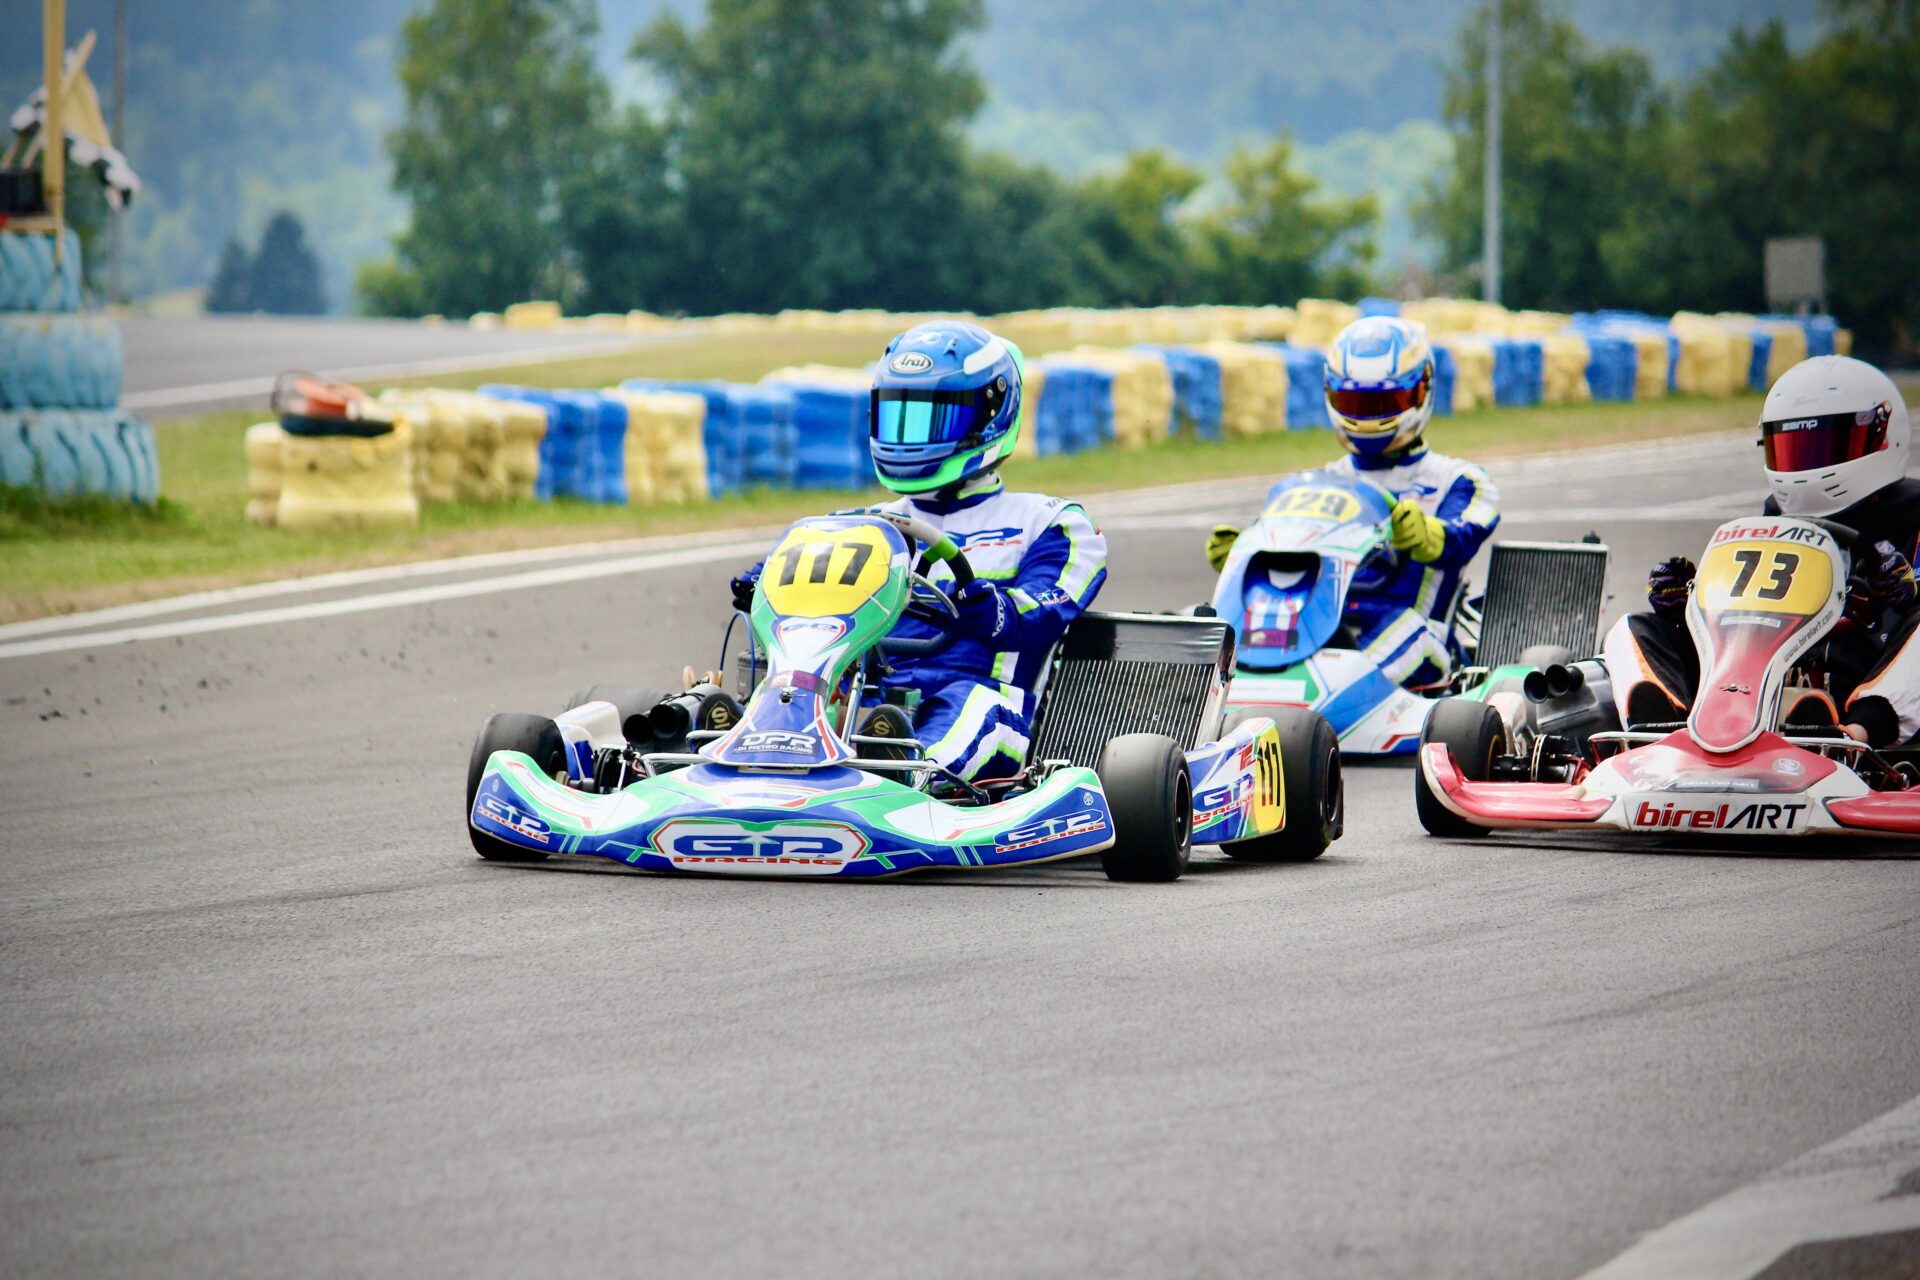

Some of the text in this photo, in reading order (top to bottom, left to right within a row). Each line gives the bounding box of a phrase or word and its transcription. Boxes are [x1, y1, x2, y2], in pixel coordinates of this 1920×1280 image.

[901, 353, 927, 367] Arai
[1781, 418, 1818, 432] zamp
[1713, 525, 1829, 546] birelART
[778, 542, 874, 587] 117
[1729, 550, 1801, 600] 73
[742, 732, 817, 749] DPR
[780, 744, 813, 753] RACING
[1634, 801, 1807, 829] birelART
[995, 822, 1106, 853] RACING
[673, 856, 843, 865] RACING
